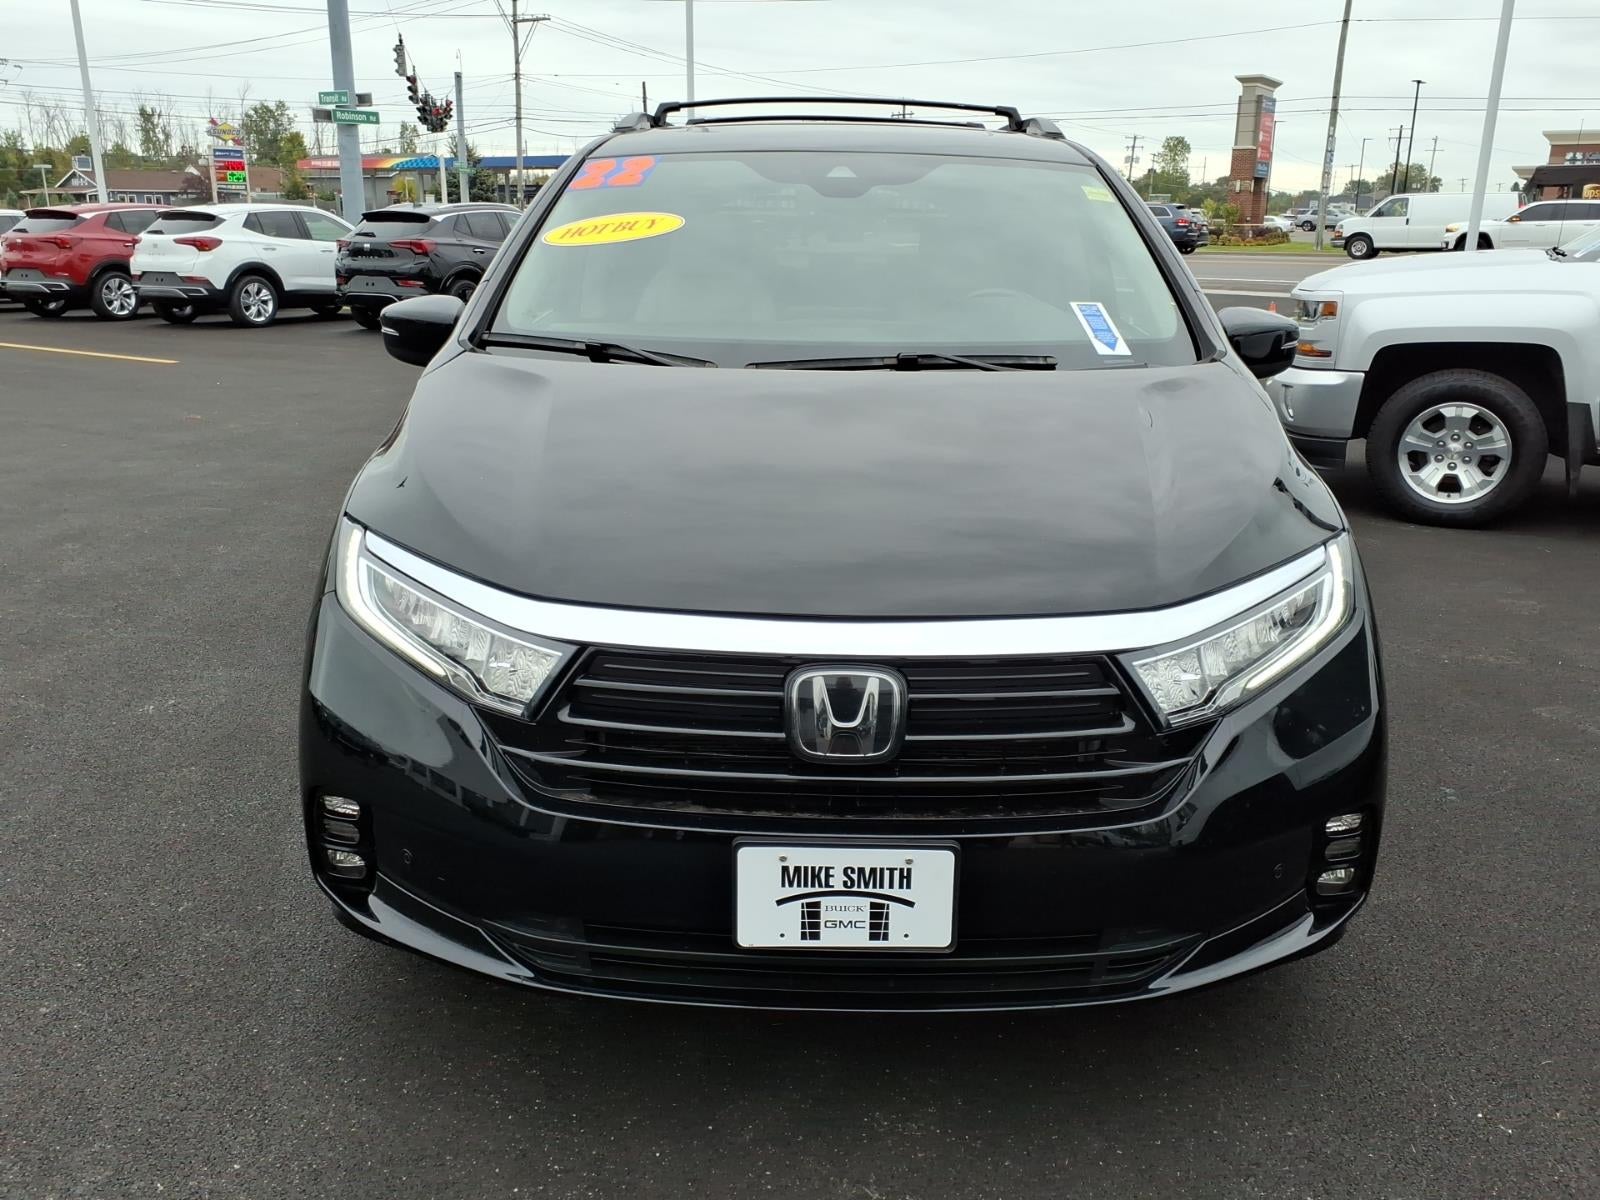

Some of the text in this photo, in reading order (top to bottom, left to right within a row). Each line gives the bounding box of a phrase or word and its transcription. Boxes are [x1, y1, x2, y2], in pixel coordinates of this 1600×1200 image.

[320, 94, 339, 102] Transit
[336, 111, 367, 121] Robinson
[213, 128, 241, 136] SUNOCO
[781, 865, 912, 890] MIKE SMITH
[824, 920, 866, 929] GMC
